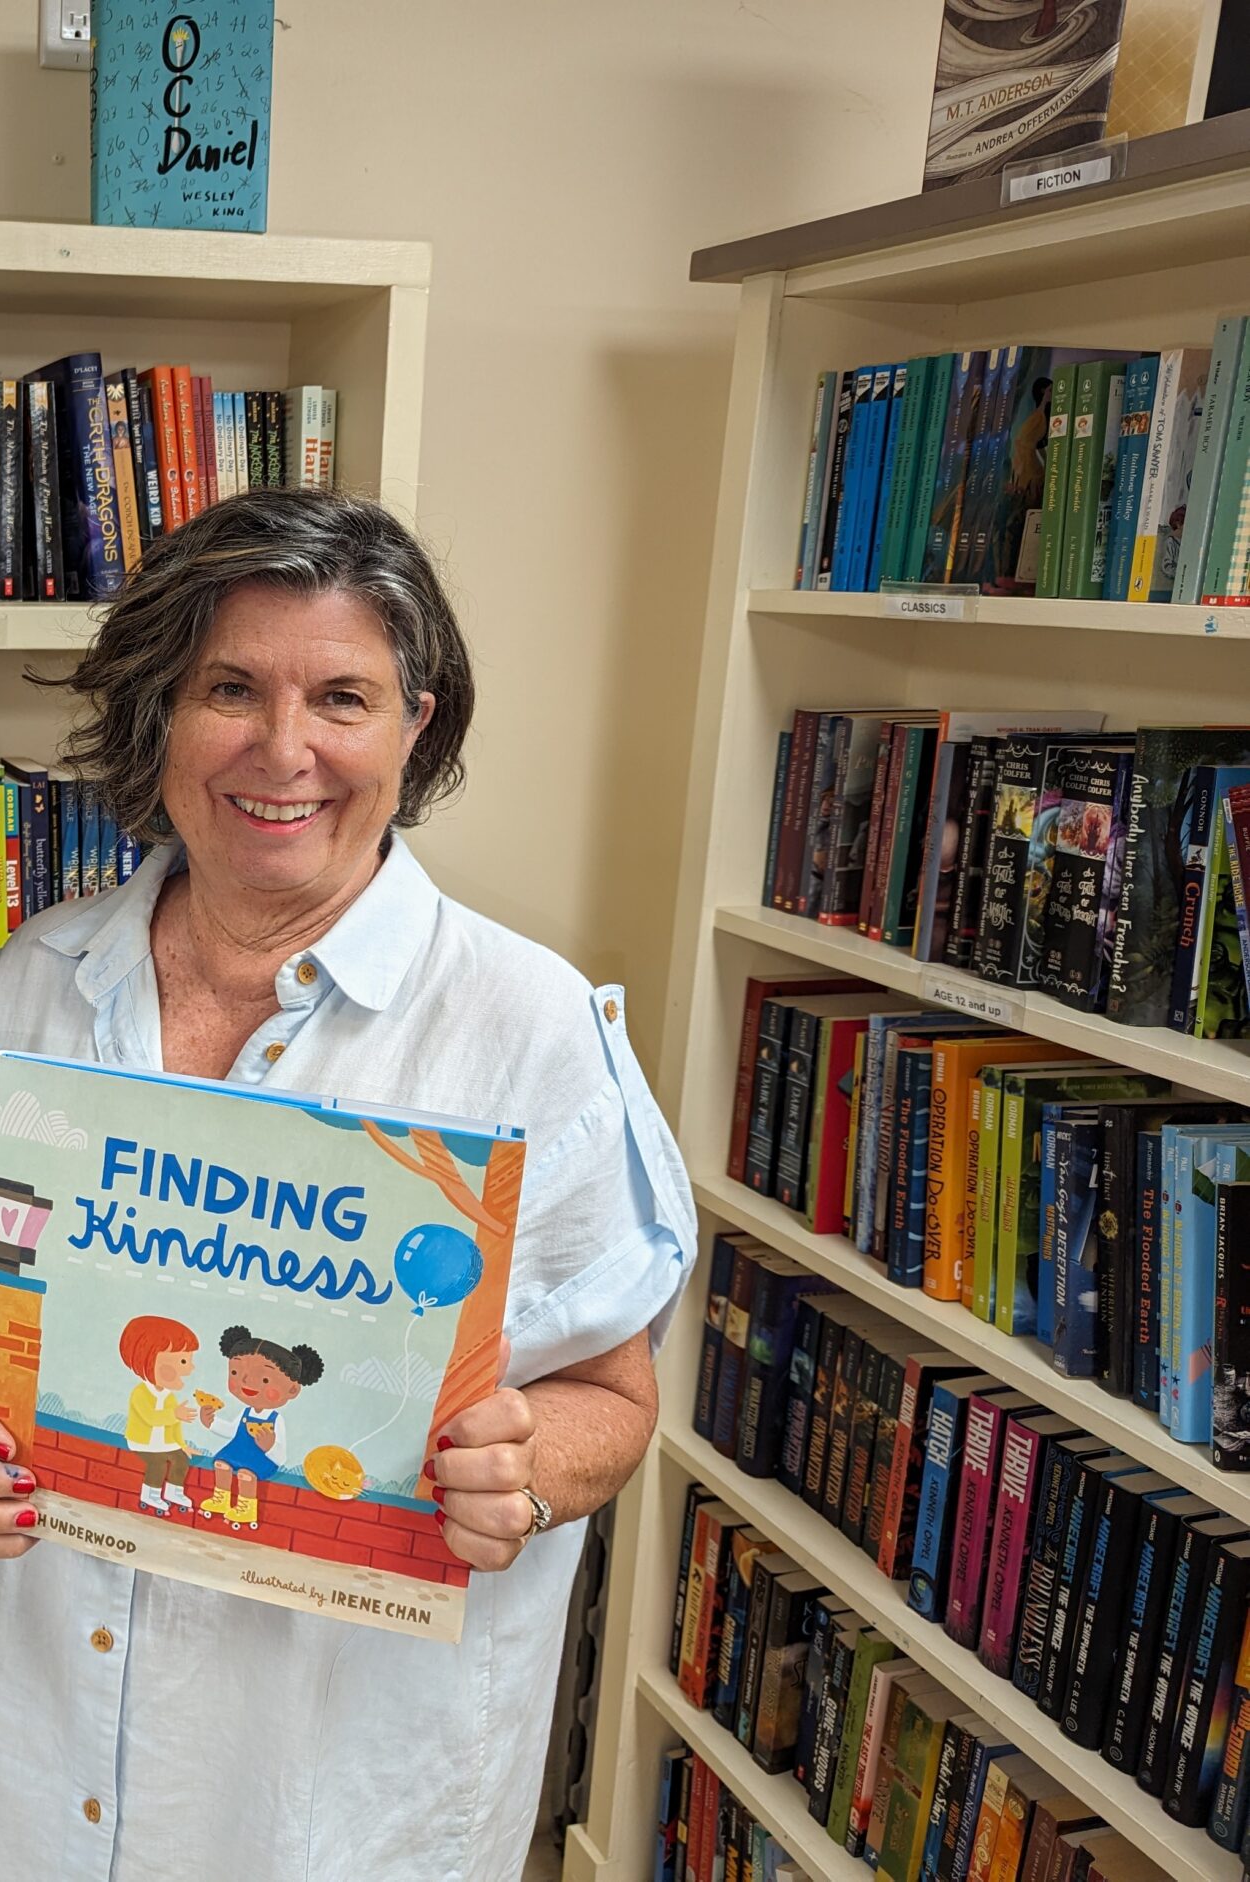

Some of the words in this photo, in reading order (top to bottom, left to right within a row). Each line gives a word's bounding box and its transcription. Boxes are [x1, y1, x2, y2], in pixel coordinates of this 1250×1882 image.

[978, 72, 1054, 112] ANDERSON
[974, 132, 1014, 155] ANDREA
[1017, 87, 1079, 135] OFFERMANN
[183, 191, 235, 202] WESLEY
[1036, 169, 1081, 190] FICTION
[213, 208, 244, 217] KING
[74, 366, 98, 374] D'LACEY
[1153, 414, 1167, 443] TOM
[81, 444, 92, 465] THE
[1052, 440, 1060, 461] Anne
[1149, 443, 1162, 480] SAWYER
[84, 467, 94, 490] NEW
[146, 470, 161, 507] WEIRD
[88, 491, 97, 516] AGE
[95, 467, 118, 564] DRAGONS
[151, 507, 162, 526] KID
[901, 601, 946, 614] CLASSICS
[1003, 770, 1031, 780] COLFER
[1005, 761, 1029, 771] CHRIS
[1197, 789, 1208, 833] CONNOR
[6, 860, 19, 890] Level
[32, 838, 46, 877] butterfly
[7, 891, 19, 908] 13
[35, 877, 48, 912] yellow
[1180, 882, 1200, 949] Crunch
[934, 989, 953, 1003] AGE
[955, 996, 966, 1006] 12
[968, 1001, 986, 1012] and
[988, 1006, 1001, 1017] up
[935, 1052, 945, 1083] KORMAN
[927, 1088, 948, 1174] OPERATION
[1008, 1100, 1018, 1139] KORMAN
[99, 1135, 369, 1243] FINDING
[1142, 1188, 1155, 1220] The
[66, 1195, 396, 1306] Kindness
[1054, 1229, 1068, 1307] DECEPTION
[1140, 1226, 1154, 1292] Flooded
[1217, 1234, 1226, 1280] JACQUES
[1139, 1296, 1151, 1345] Earth
[898, 1382, 917, 1429] BLOOM
[926, 1408, 954, 1471] HATCH
[963, 1405, 995, 1477] THRIVE
[961, 1479, 978, 1541] KENNETH
[48, 1516, 138, 1555] UNDERWOOD
[1059, 1494, 1085, 1584] MINECRAFT
[957, 1540, 971, 1585] OPPEL
[1085, 1514, 1111, 1601] MINECRAFT
[240, 1570, 306, 1594] illustrated
[309, 1586, 327, 1607] by
[331, 1589, 381, 1614] IRENE
[385, 1602, 431, 1625] CHAN
[1018, 1559, 1054, 1672] BOUNDLESS
[1084, 1603, 1096, 1624] THE
[1076, 1622, 1093, 1675] SHIPWRECK
[1193, 1582, 1223, 1678] MINECRAFT
[1190, 1679, 1204, 1705] THE
[822, 1696, 838, 1735] GONE
[1180, 1703, 1200, 1752] VOYAGE
[813, 1746, 831, 1793] WOODS
[1176, 1753, 1187, 1780] JASON
[1223, 1722, 1243, 1782] SQUAD
[1173, 1779, 1181, 1796] FRY
[931, 1793, 948, 1827] Stars
